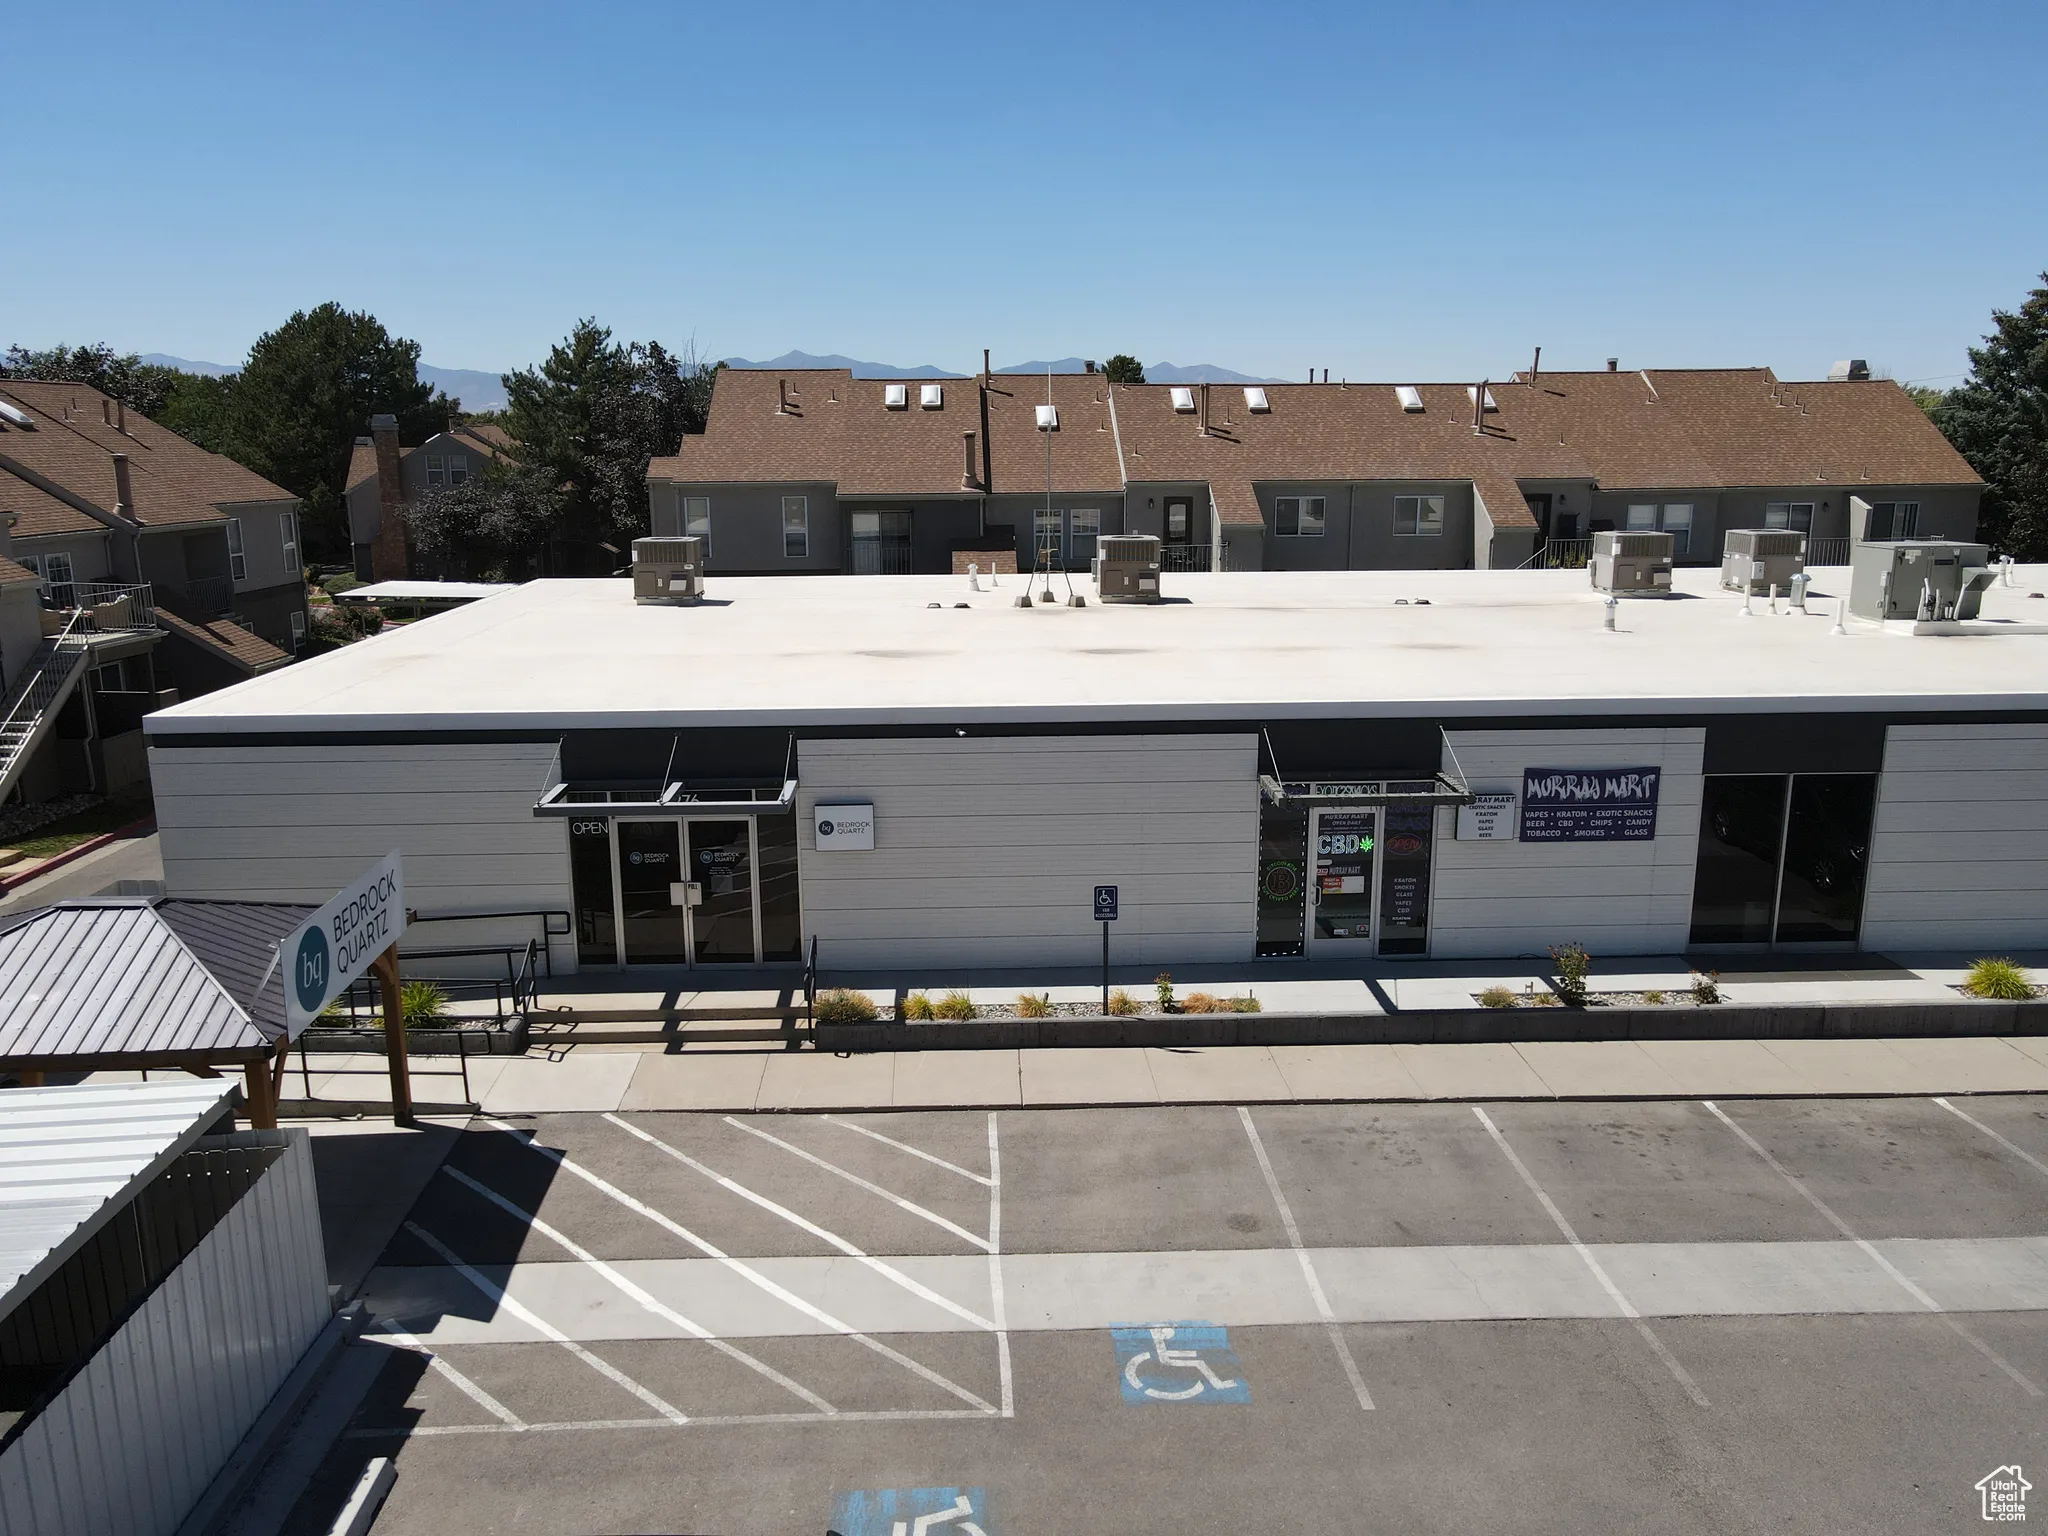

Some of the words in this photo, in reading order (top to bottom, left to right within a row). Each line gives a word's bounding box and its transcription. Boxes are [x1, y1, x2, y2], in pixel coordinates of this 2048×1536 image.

[1527, 775, 1600, 801] MURRAY
[1604, 774, 1655, 800] MART
[1556, 810, 1588, 818] KRATOM
[1558, 819, 1574, 827] CBD
[1626, 818, 1652, 826] CANDY
[572, 822, 608, 834] OPEN
[1574, 829, 1605, 837] SMOKES
[1624, 828, 1648, 836] GLASS
[1317, 834, 1360, 855] CBD
[333, 869, 397, 944] BEDROCK
[337, 908, 389, 974] QUARTZ
[302, 951, 323, 988] bq
